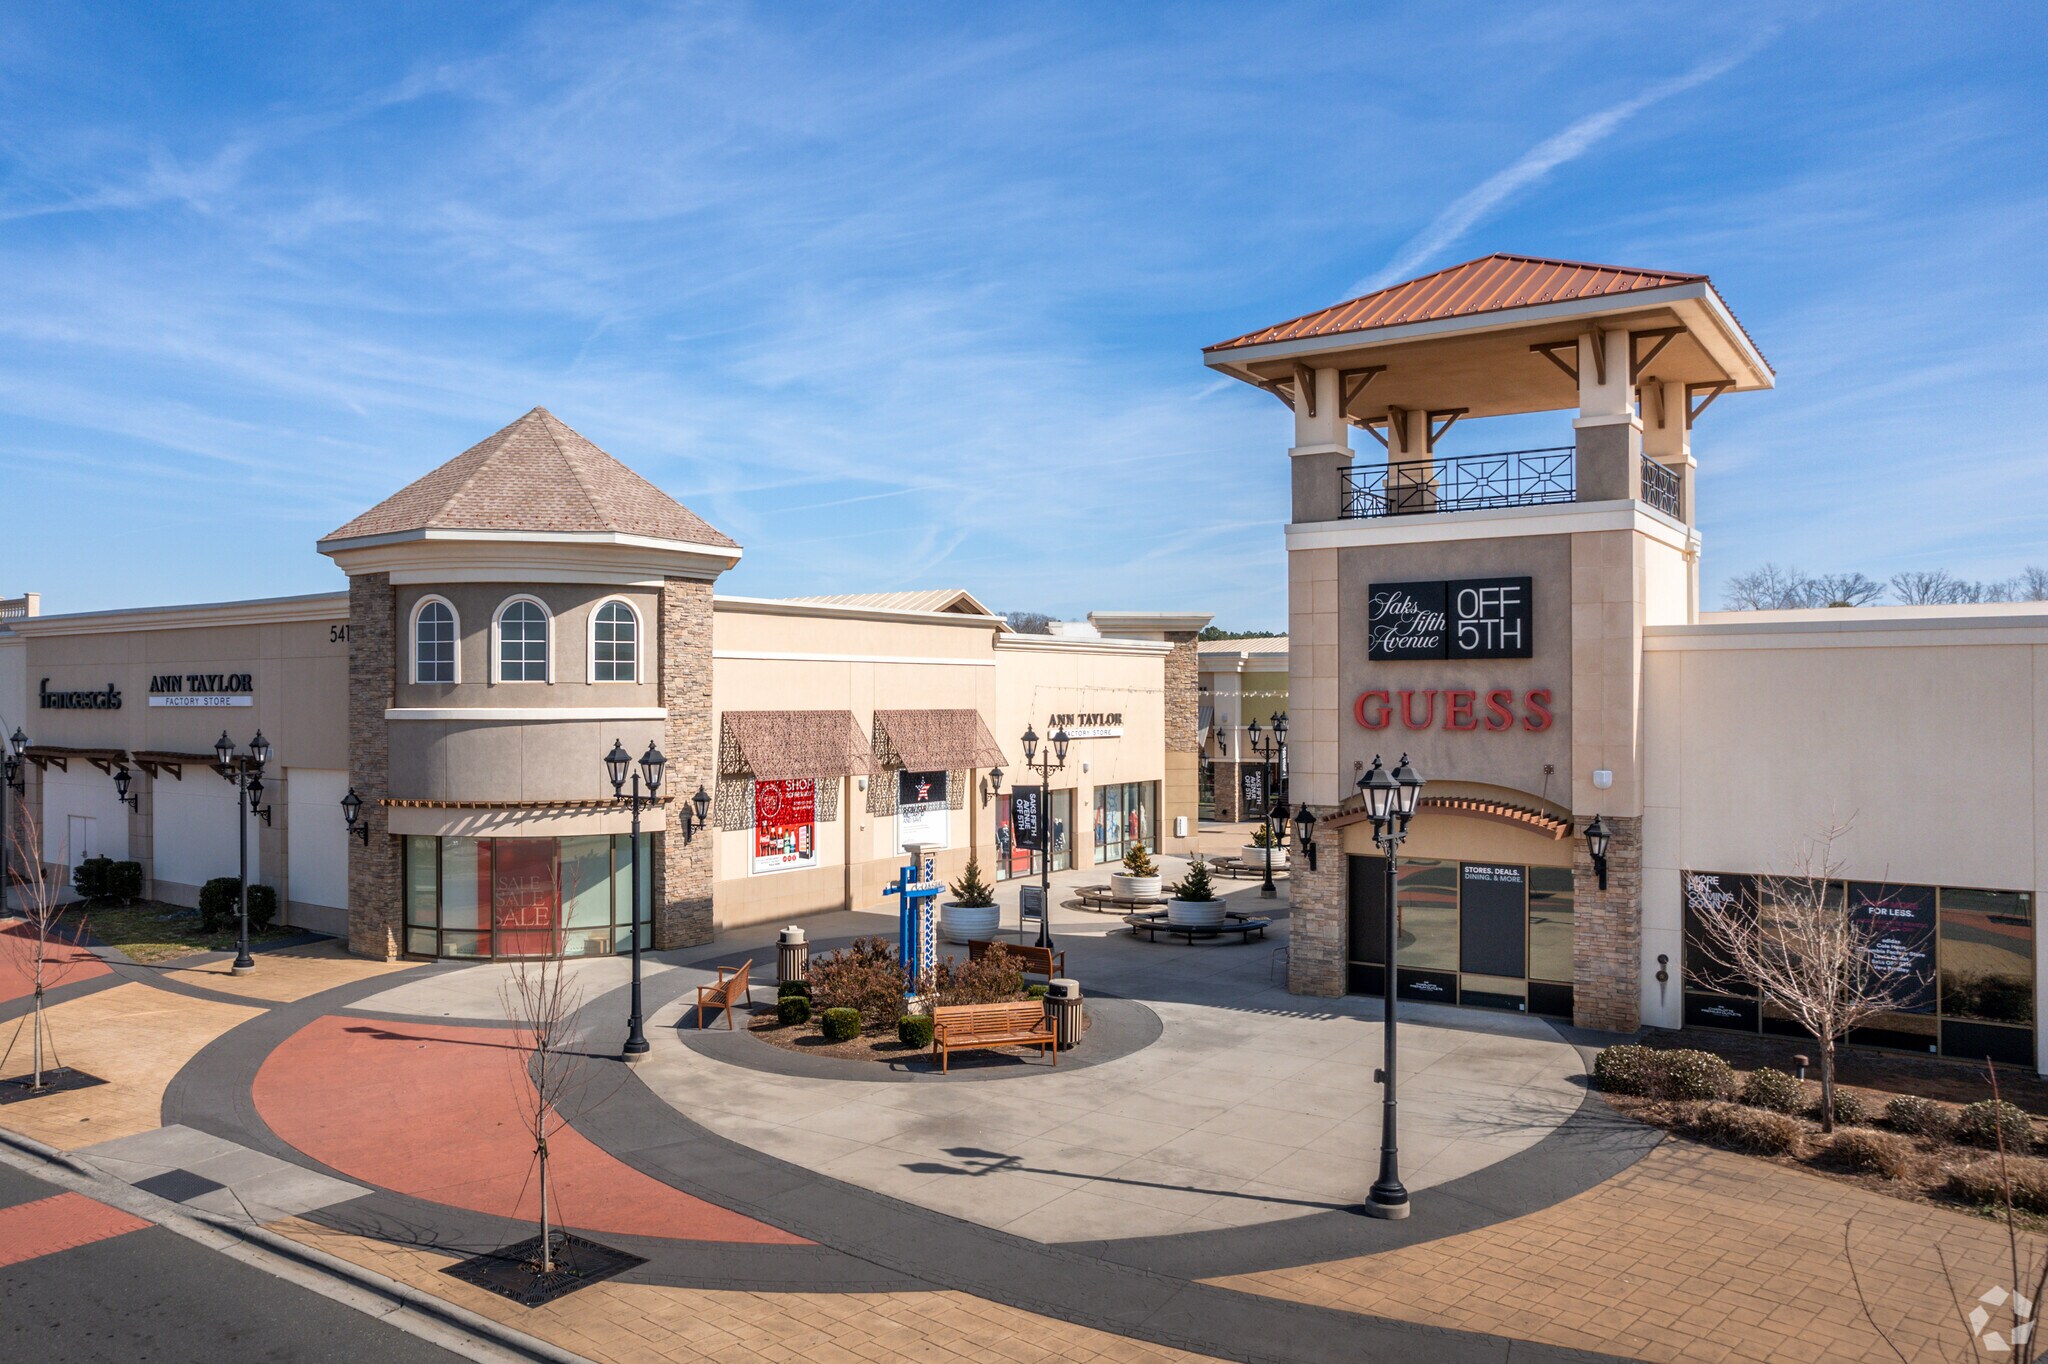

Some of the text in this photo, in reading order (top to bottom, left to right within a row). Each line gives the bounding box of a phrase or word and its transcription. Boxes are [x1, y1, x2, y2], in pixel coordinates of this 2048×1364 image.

[1369, 591, 1418, 622] Saks
[1457, 586, 1521, 619] OFF
[1369, 624, 1440, 653] Avenue
[1458, 618, 1522, 650] 5TH
[149, 673, 253, 693] ANN TAYLOR
[39, 677, 122, 710] francesca's
[165, 696, 231, 706] FACTORY STORE
[1048, 712, 1123, 728] ANN TAYLOR
[1354, 689, 1554, 733] GUESS
[785, 777, 814, 791] SHOP
[1029, 793, 1037, 814] SAKS
[1016, 799, 1025, 831] OFF 5TH
[1023, 799, 1031, 830] AVENUE
[1464, 866, 1520, 876] STORES. DEALS.
[1464, 873, 1493, 881] DINING.
[1499, 875, 1524, 883] MORE.
[498, 876, 541, 890] SALE
[495, 890, 545, 907] SALE
[496, 907, 550, 926] SALE
[1868, 907, 1915, 917] FOR LESS.
